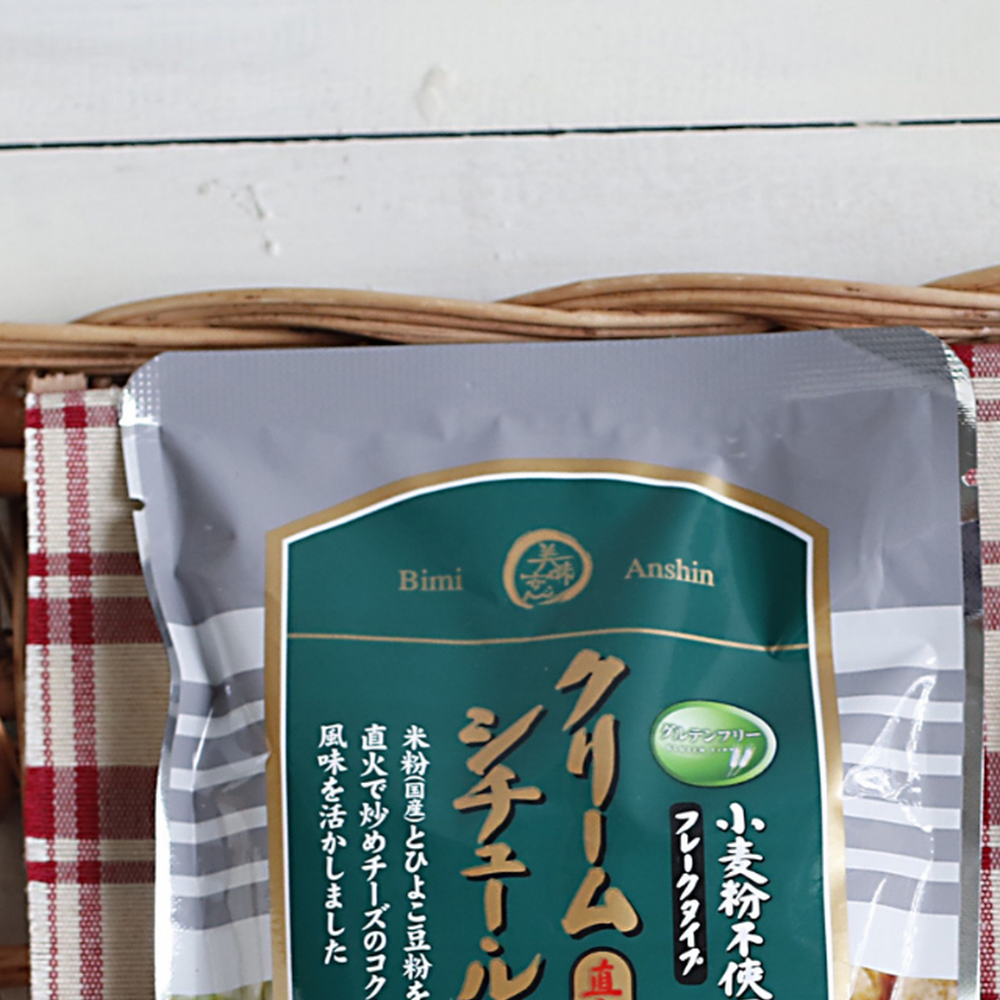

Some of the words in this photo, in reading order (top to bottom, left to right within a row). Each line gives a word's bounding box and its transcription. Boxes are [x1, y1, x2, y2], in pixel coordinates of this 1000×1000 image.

[398, 568, 463, 591] Bimi
[624, 558, 715, 587] Anshin
[661, 723, 761, 742] グルテンフリー
[554, 649, 641, 936] クリーム
[317, 723, 348, 965] 風味を活かしました
[674, 810, 704, 976] フレークタイプ
